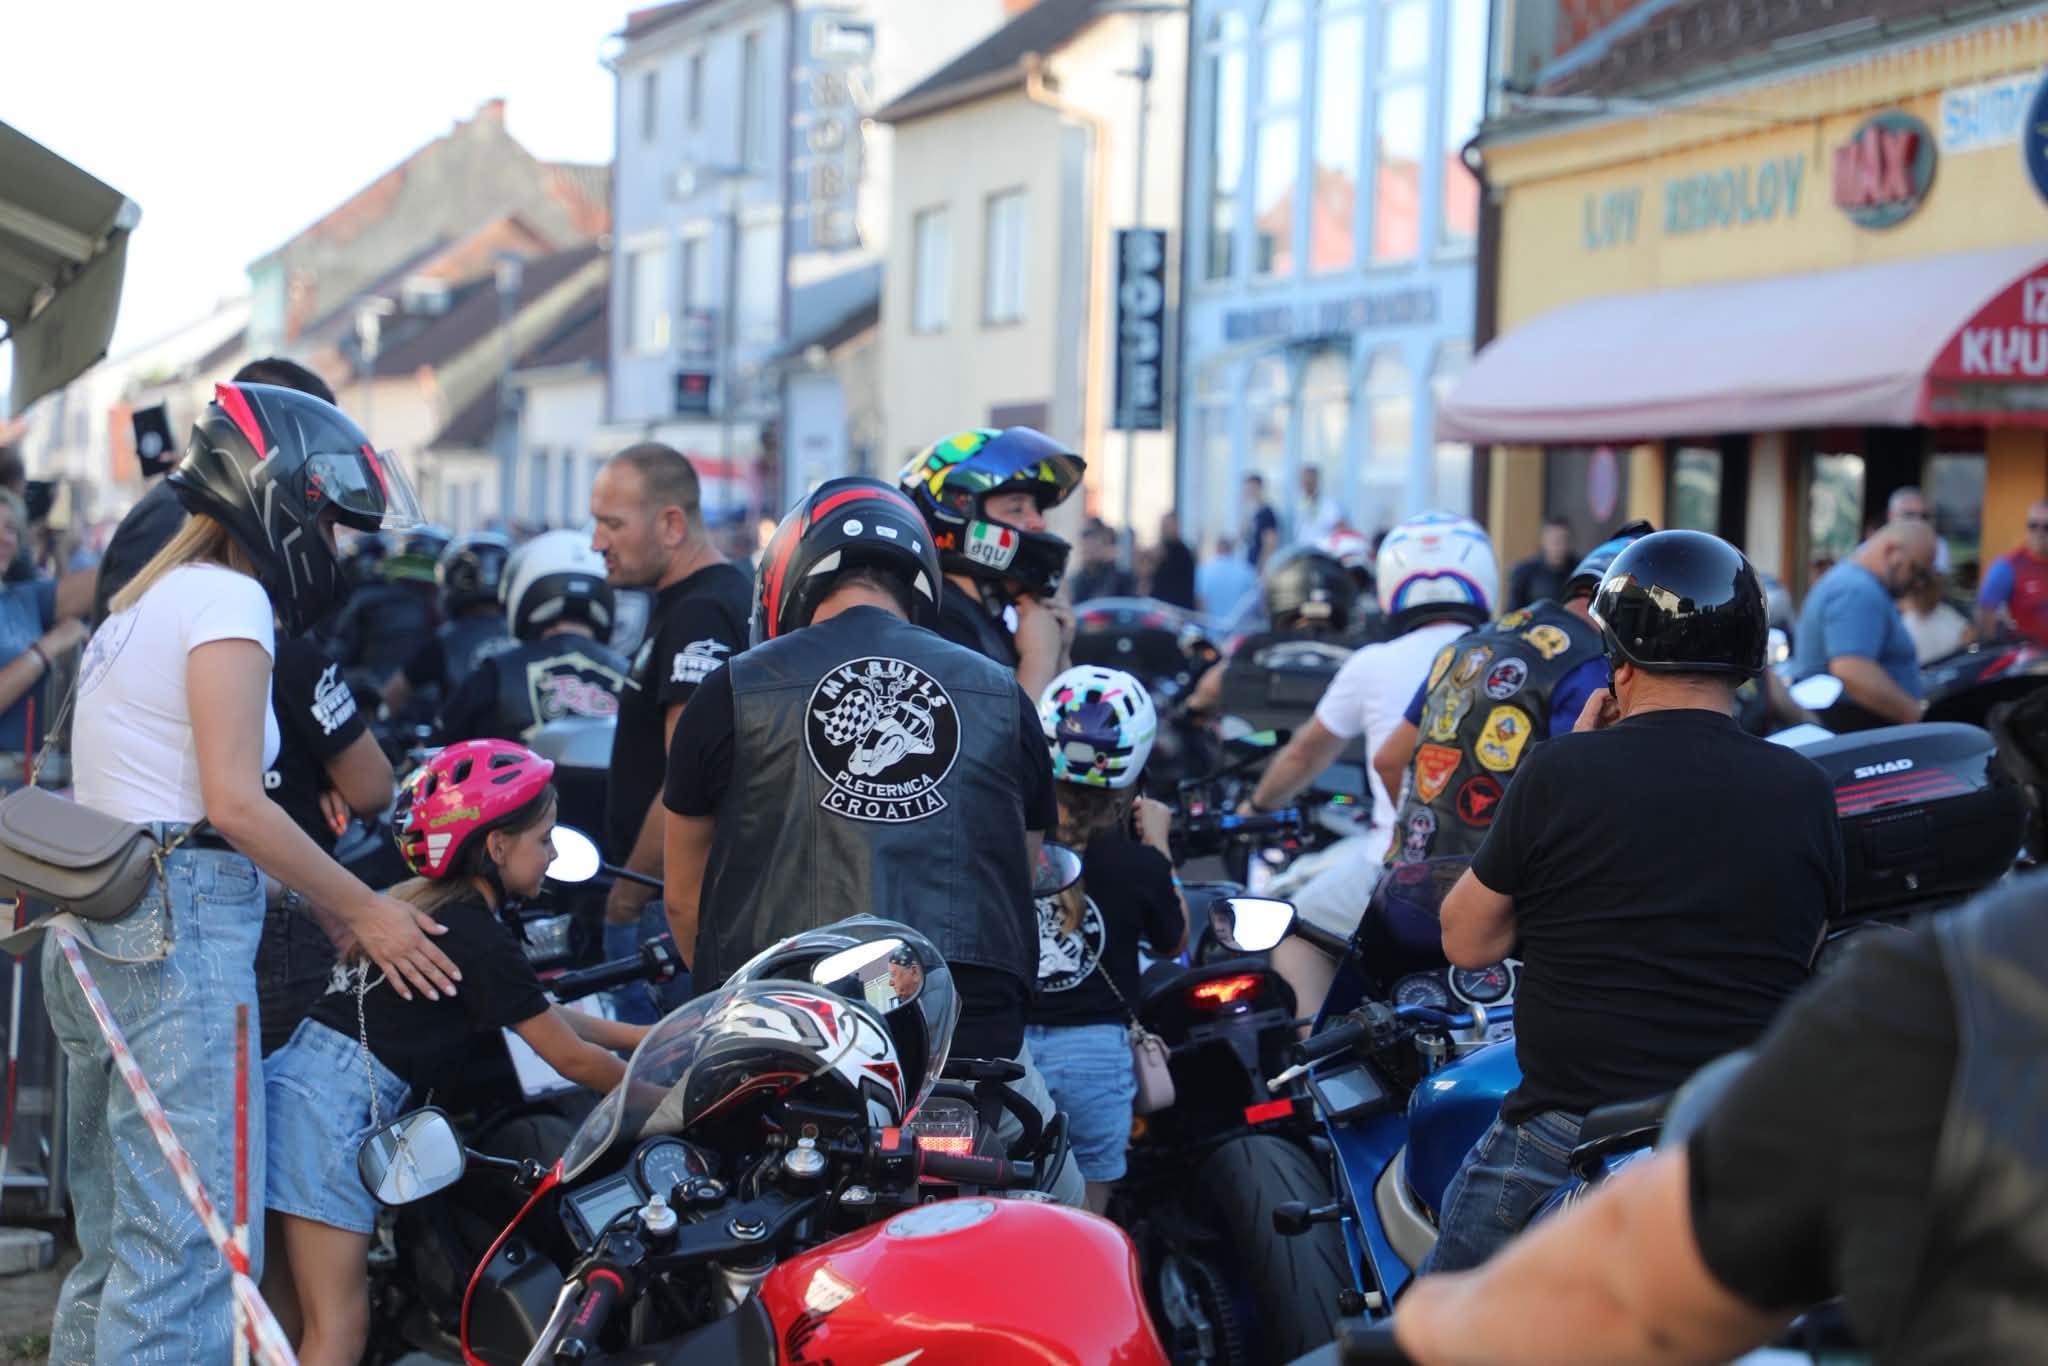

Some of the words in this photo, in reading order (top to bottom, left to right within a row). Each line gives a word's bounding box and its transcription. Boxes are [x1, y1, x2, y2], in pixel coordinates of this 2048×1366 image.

[821, 666, 859, 700] MK
[864, 660, 948, 708] BULLS
[1854, 758, 1914, 779] SHAD
[834, 769, 934, 797] PLETERNICA
[830, 791, 941, 819] CROATIA
